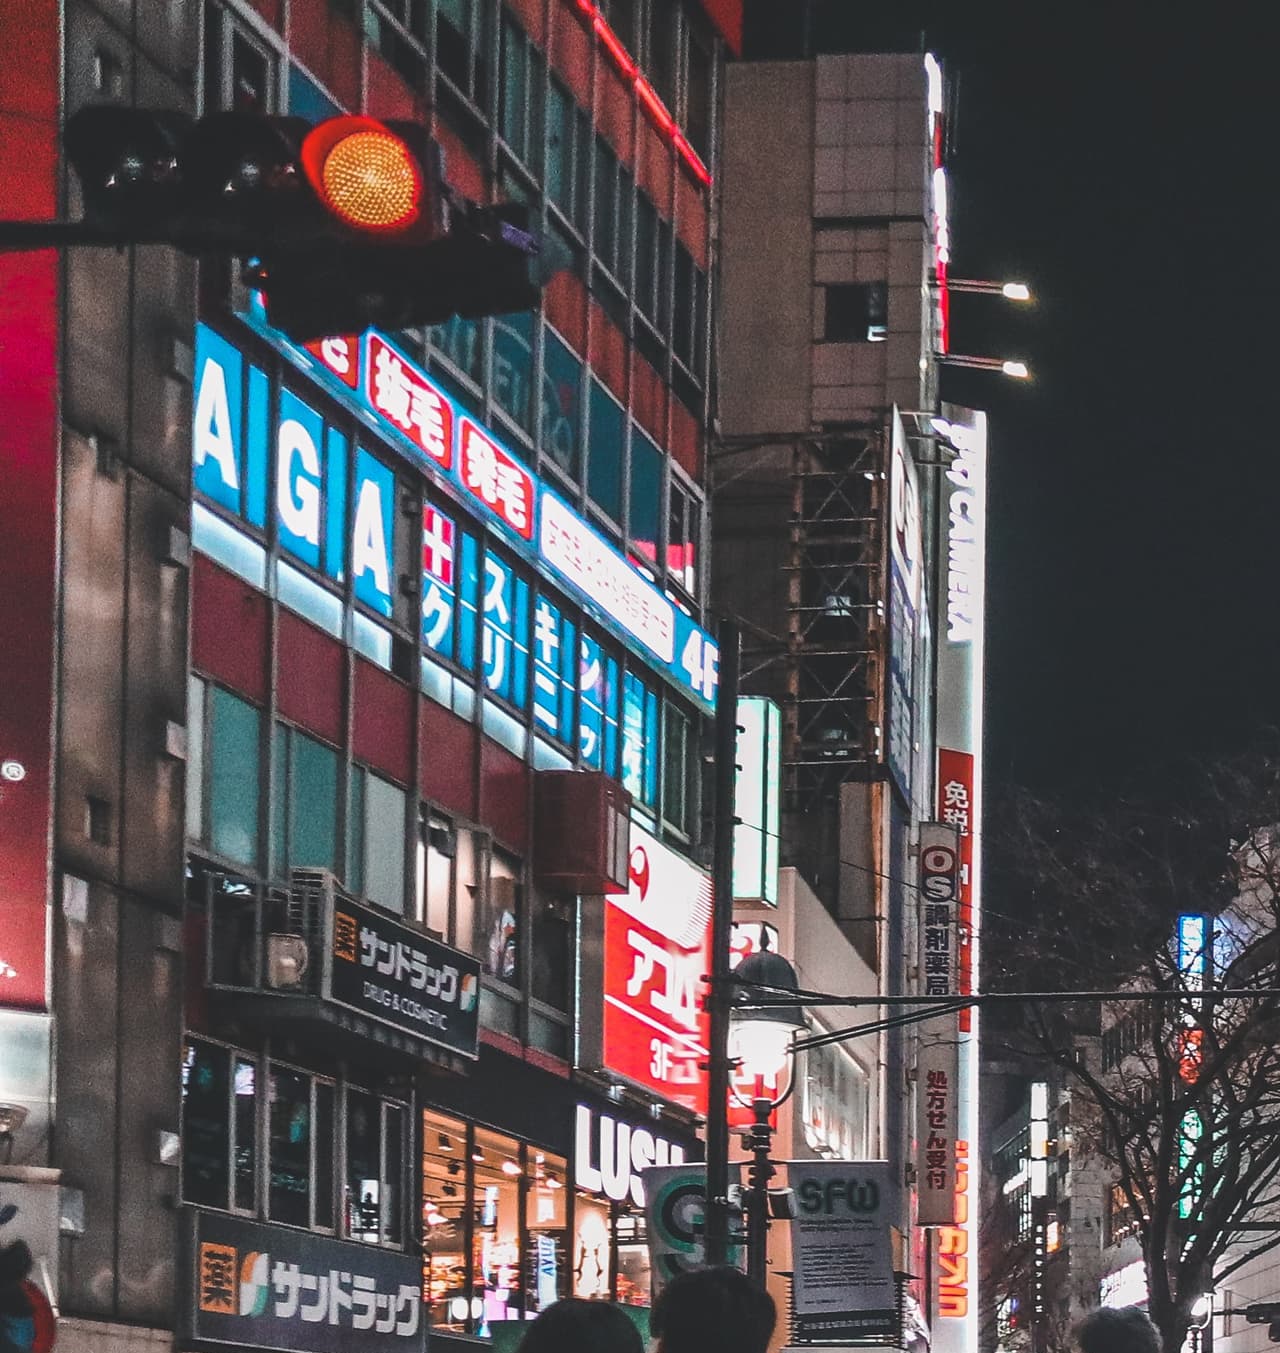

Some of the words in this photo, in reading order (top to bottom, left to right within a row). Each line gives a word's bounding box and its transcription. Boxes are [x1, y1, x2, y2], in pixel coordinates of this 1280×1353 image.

[681, 628, 719, 702] 4F
[359, 926, 459, 1003] サンドラッグ
[924, 903, 951, 996] 調剤薬局
[363, 981, 392, 1007] DRUG
[401, 997, 449, 1031] COSMETIC
[926, 1069, 948, 1191] 処方せん受付
[271, 1260, 422, 1337] サンドラッグ
